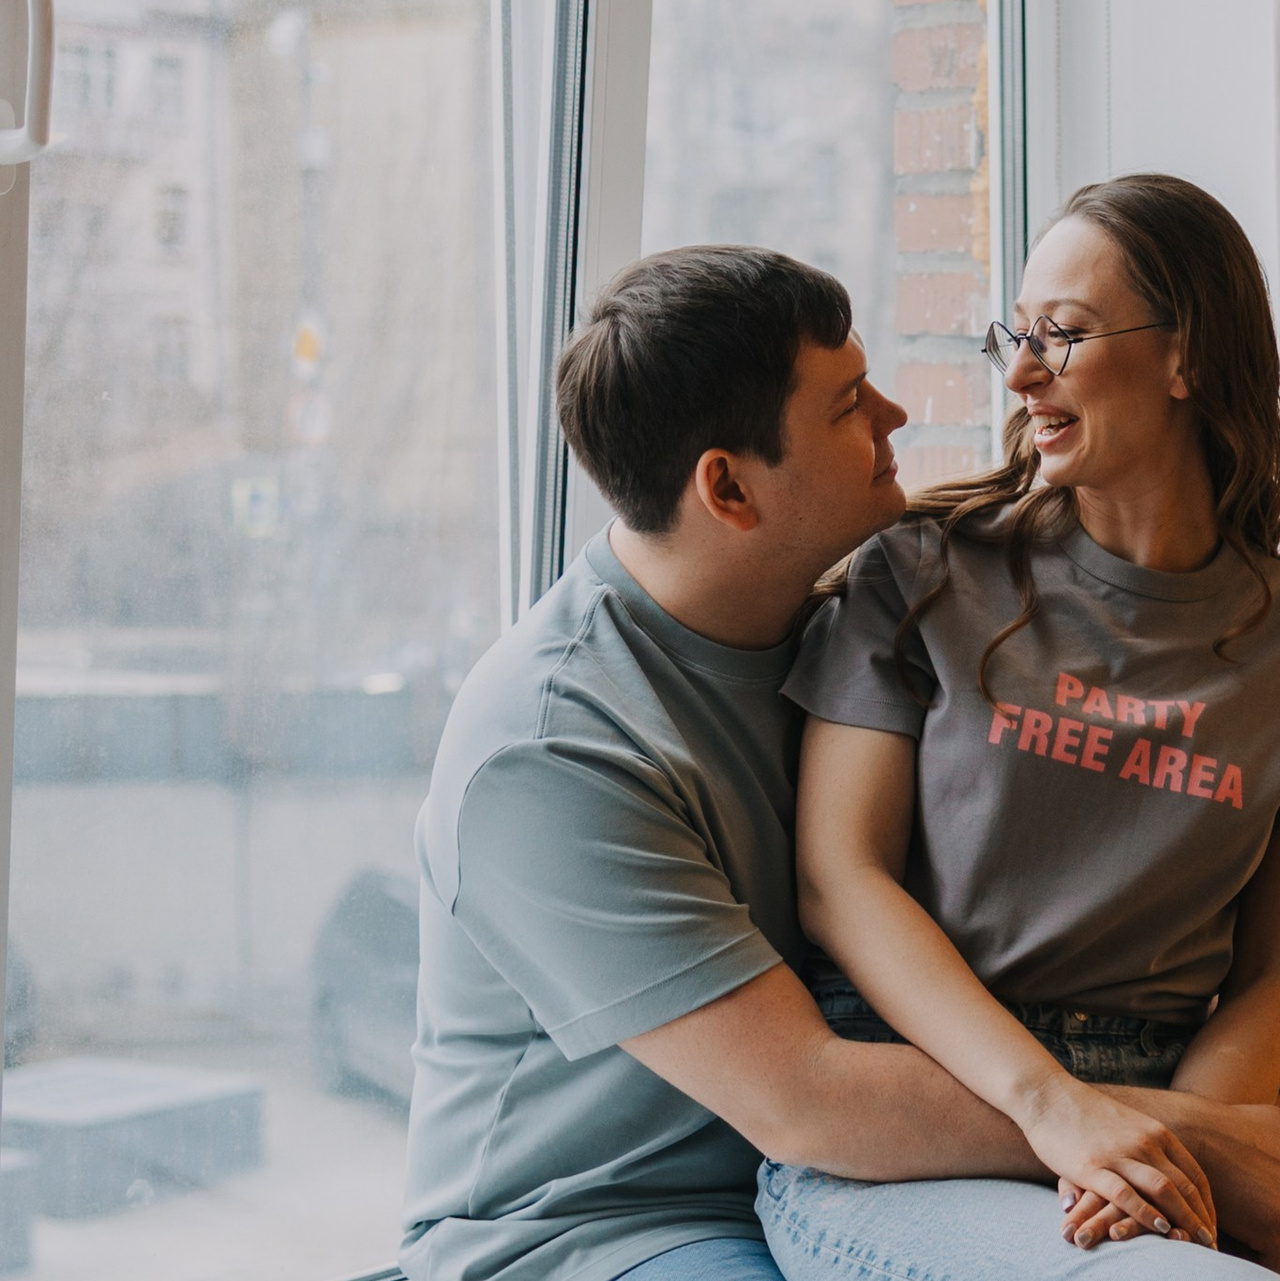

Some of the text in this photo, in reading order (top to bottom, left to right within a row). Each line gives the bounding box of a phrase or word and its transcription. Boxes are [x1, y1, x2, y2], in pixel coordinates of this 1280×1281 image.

[1054, 672, 1207, 738] PARTY
[988, 701, 1243, 810] FREE AREA
